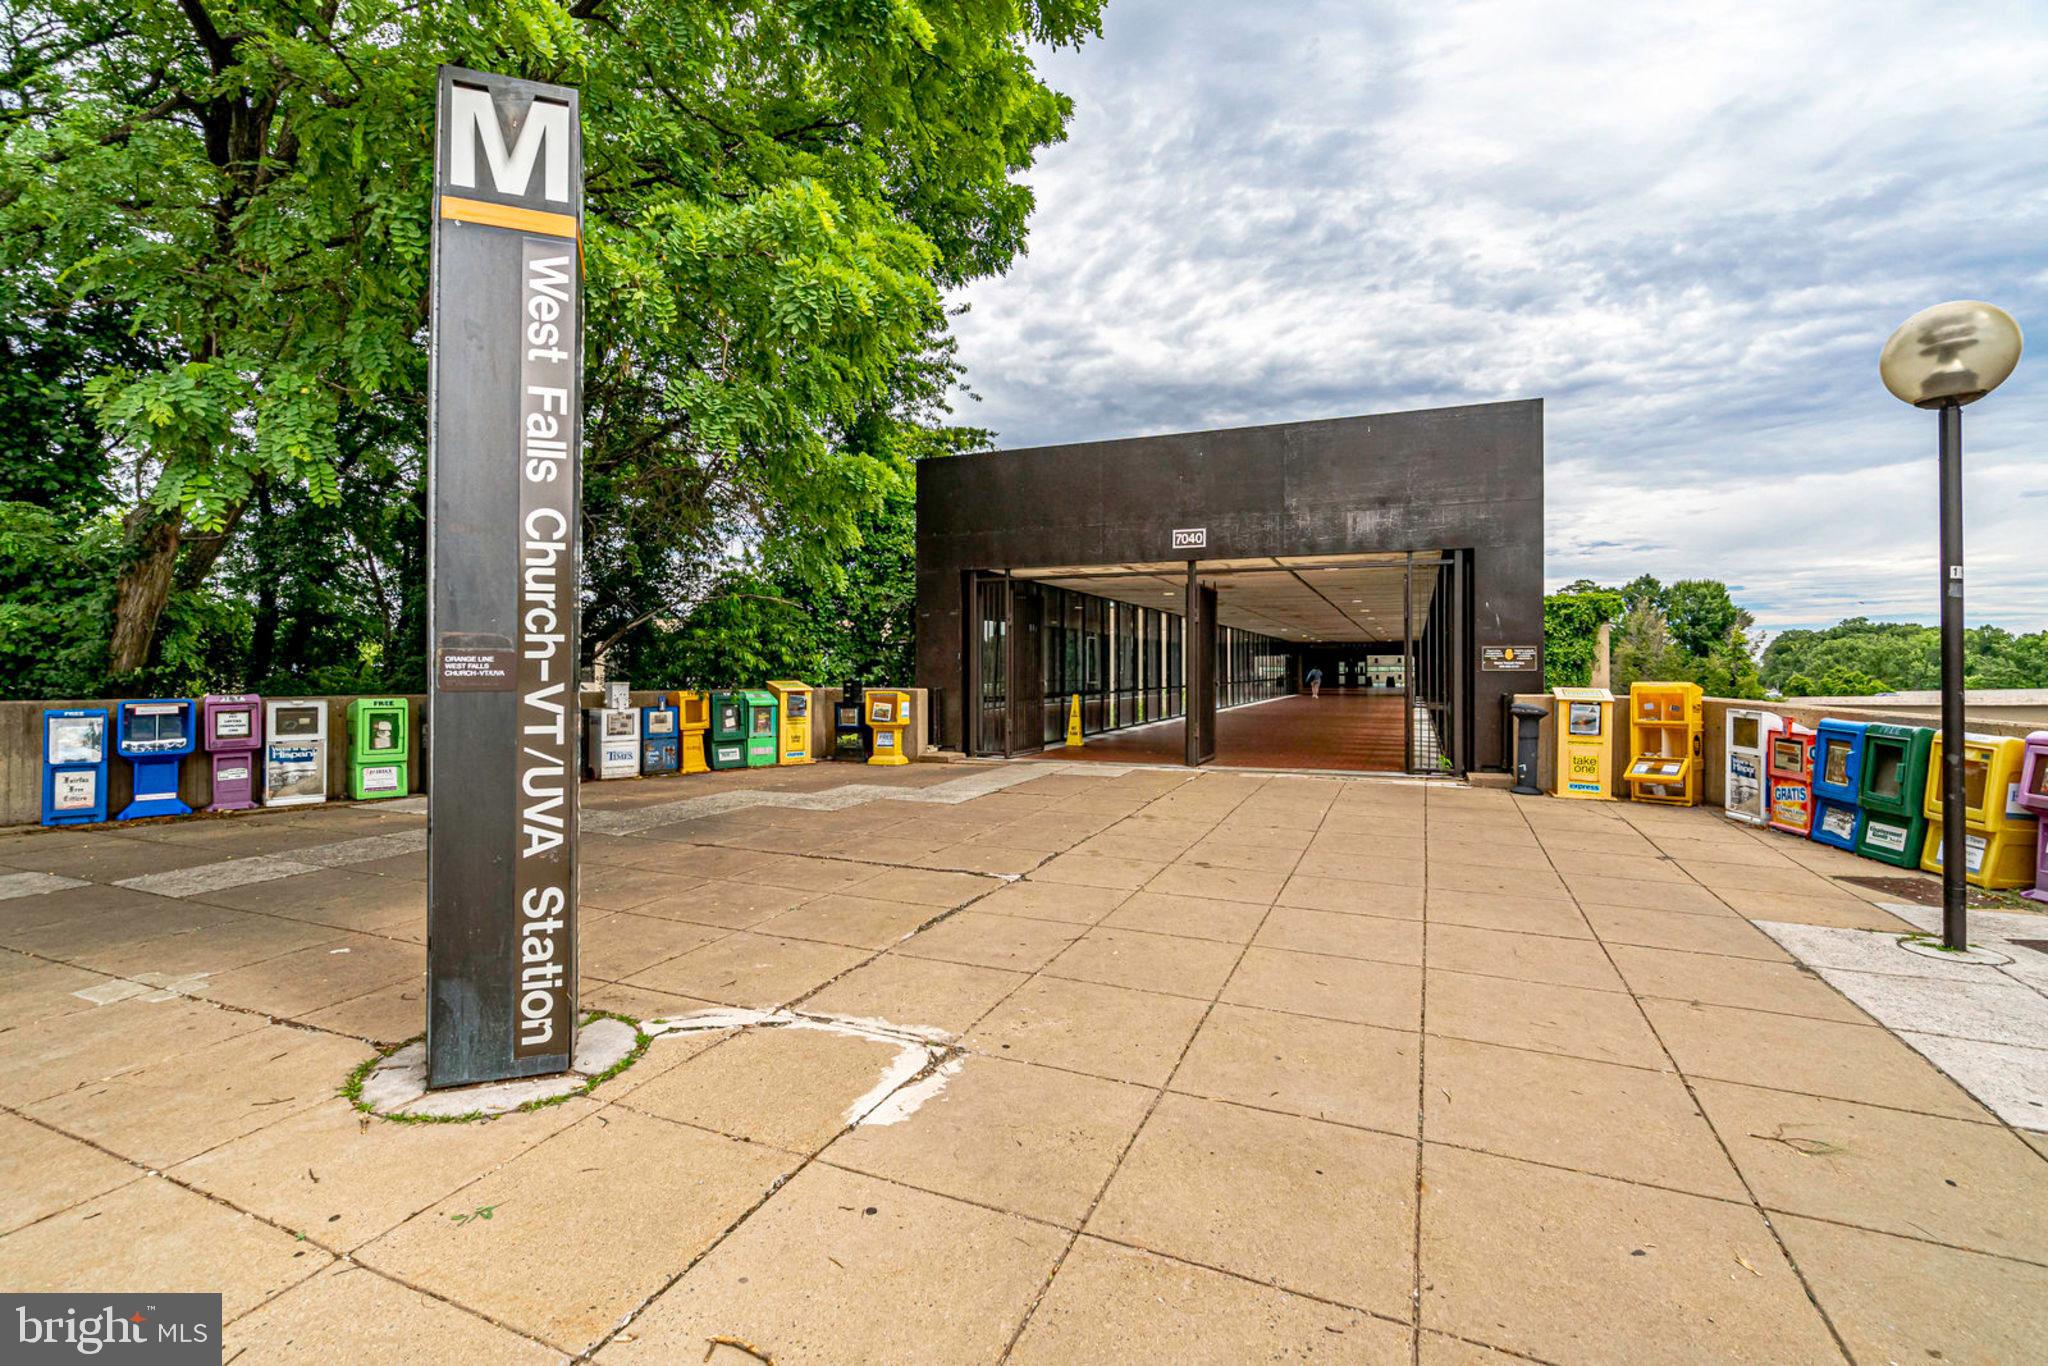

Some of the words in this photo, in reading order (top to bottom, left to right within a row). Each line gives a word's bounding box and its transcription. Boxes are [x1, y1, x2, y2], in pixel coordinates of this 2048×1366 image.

[450, 85, 570, 204] M
[527, 256, 570, 363] West
[525, 385, 568, 483] Falls
[1175, 532, 1203, 545] 7040
[444, 655, 476, 663] ORANGE
[477, 655, 495, 663] LINE
[444, 662, 466, 670] WEST
[467, 662, 490, 670] FALLS
[1573, 755, 1597, 766] take
[1574, 765, 1596, 774] one
[1774, 787, 1807, 801] GRATIS
[521, 886, 565, 1047] Station
